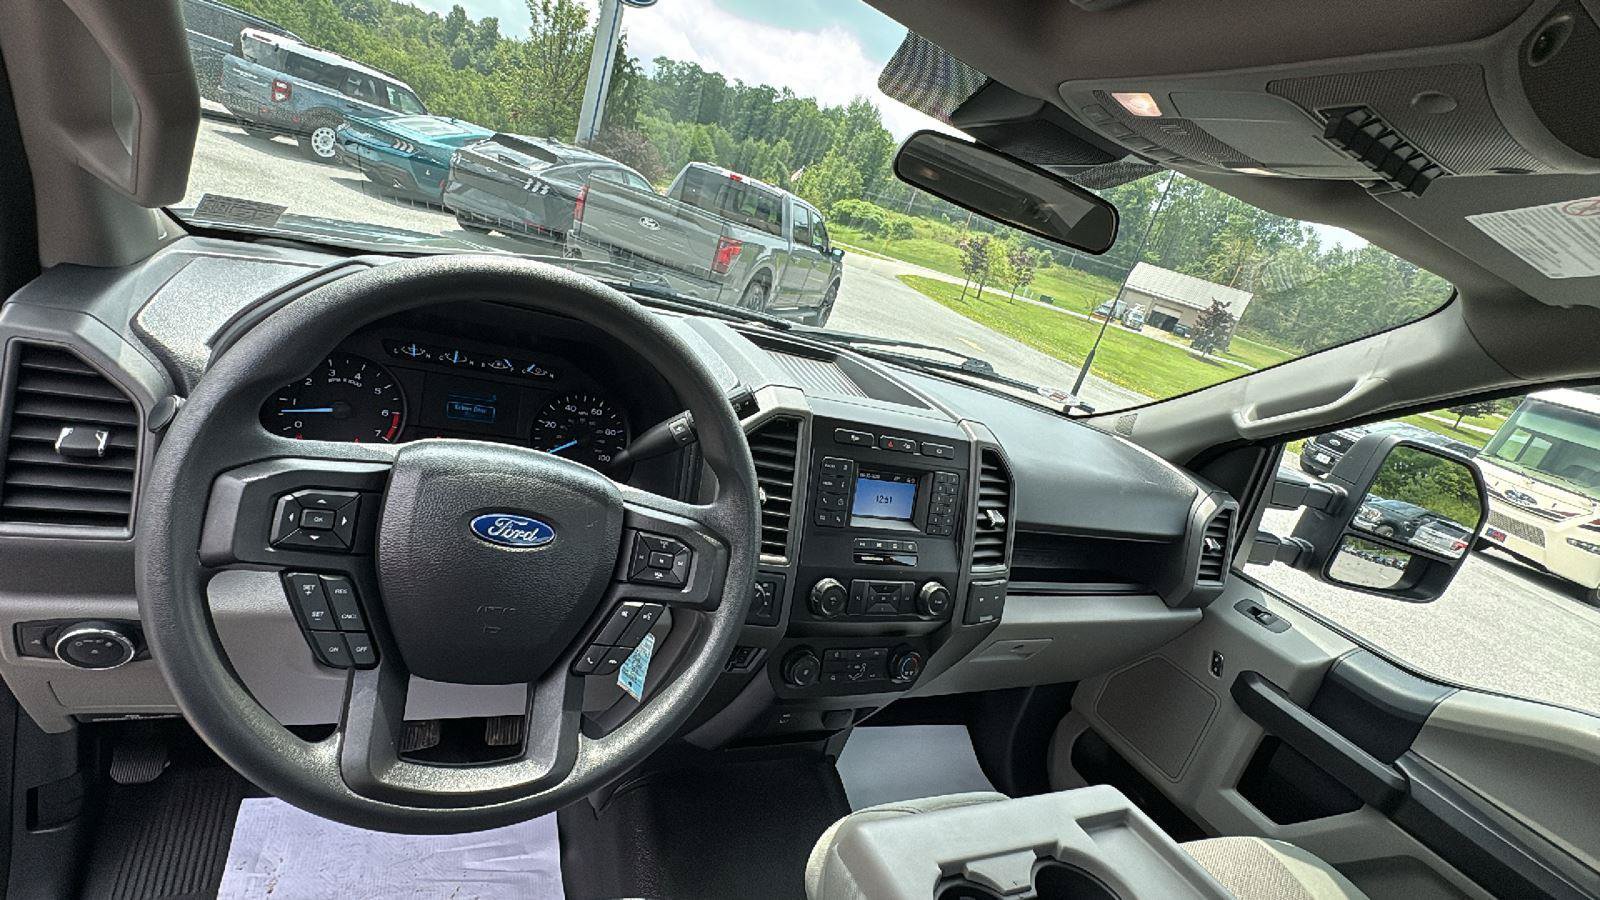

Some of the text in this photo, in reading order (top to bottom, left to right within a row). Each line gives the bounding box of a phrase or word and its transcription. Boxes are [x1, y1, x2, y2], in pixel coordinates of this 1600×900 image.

[328, 369, 336, 377] 3
[305, 378, 313, 386] 2
[564, 404, 577, 412] 40
[591, 408, 602, 416] 60
[381, 409, 389, 417] 6
[294, 421, 303, 429] 0
[375, 429, 382, 437] 7
[604, 428, 616, 436] 80
[598, 454, 611, 462] 100
[487, 518, 540, 542] Ford
